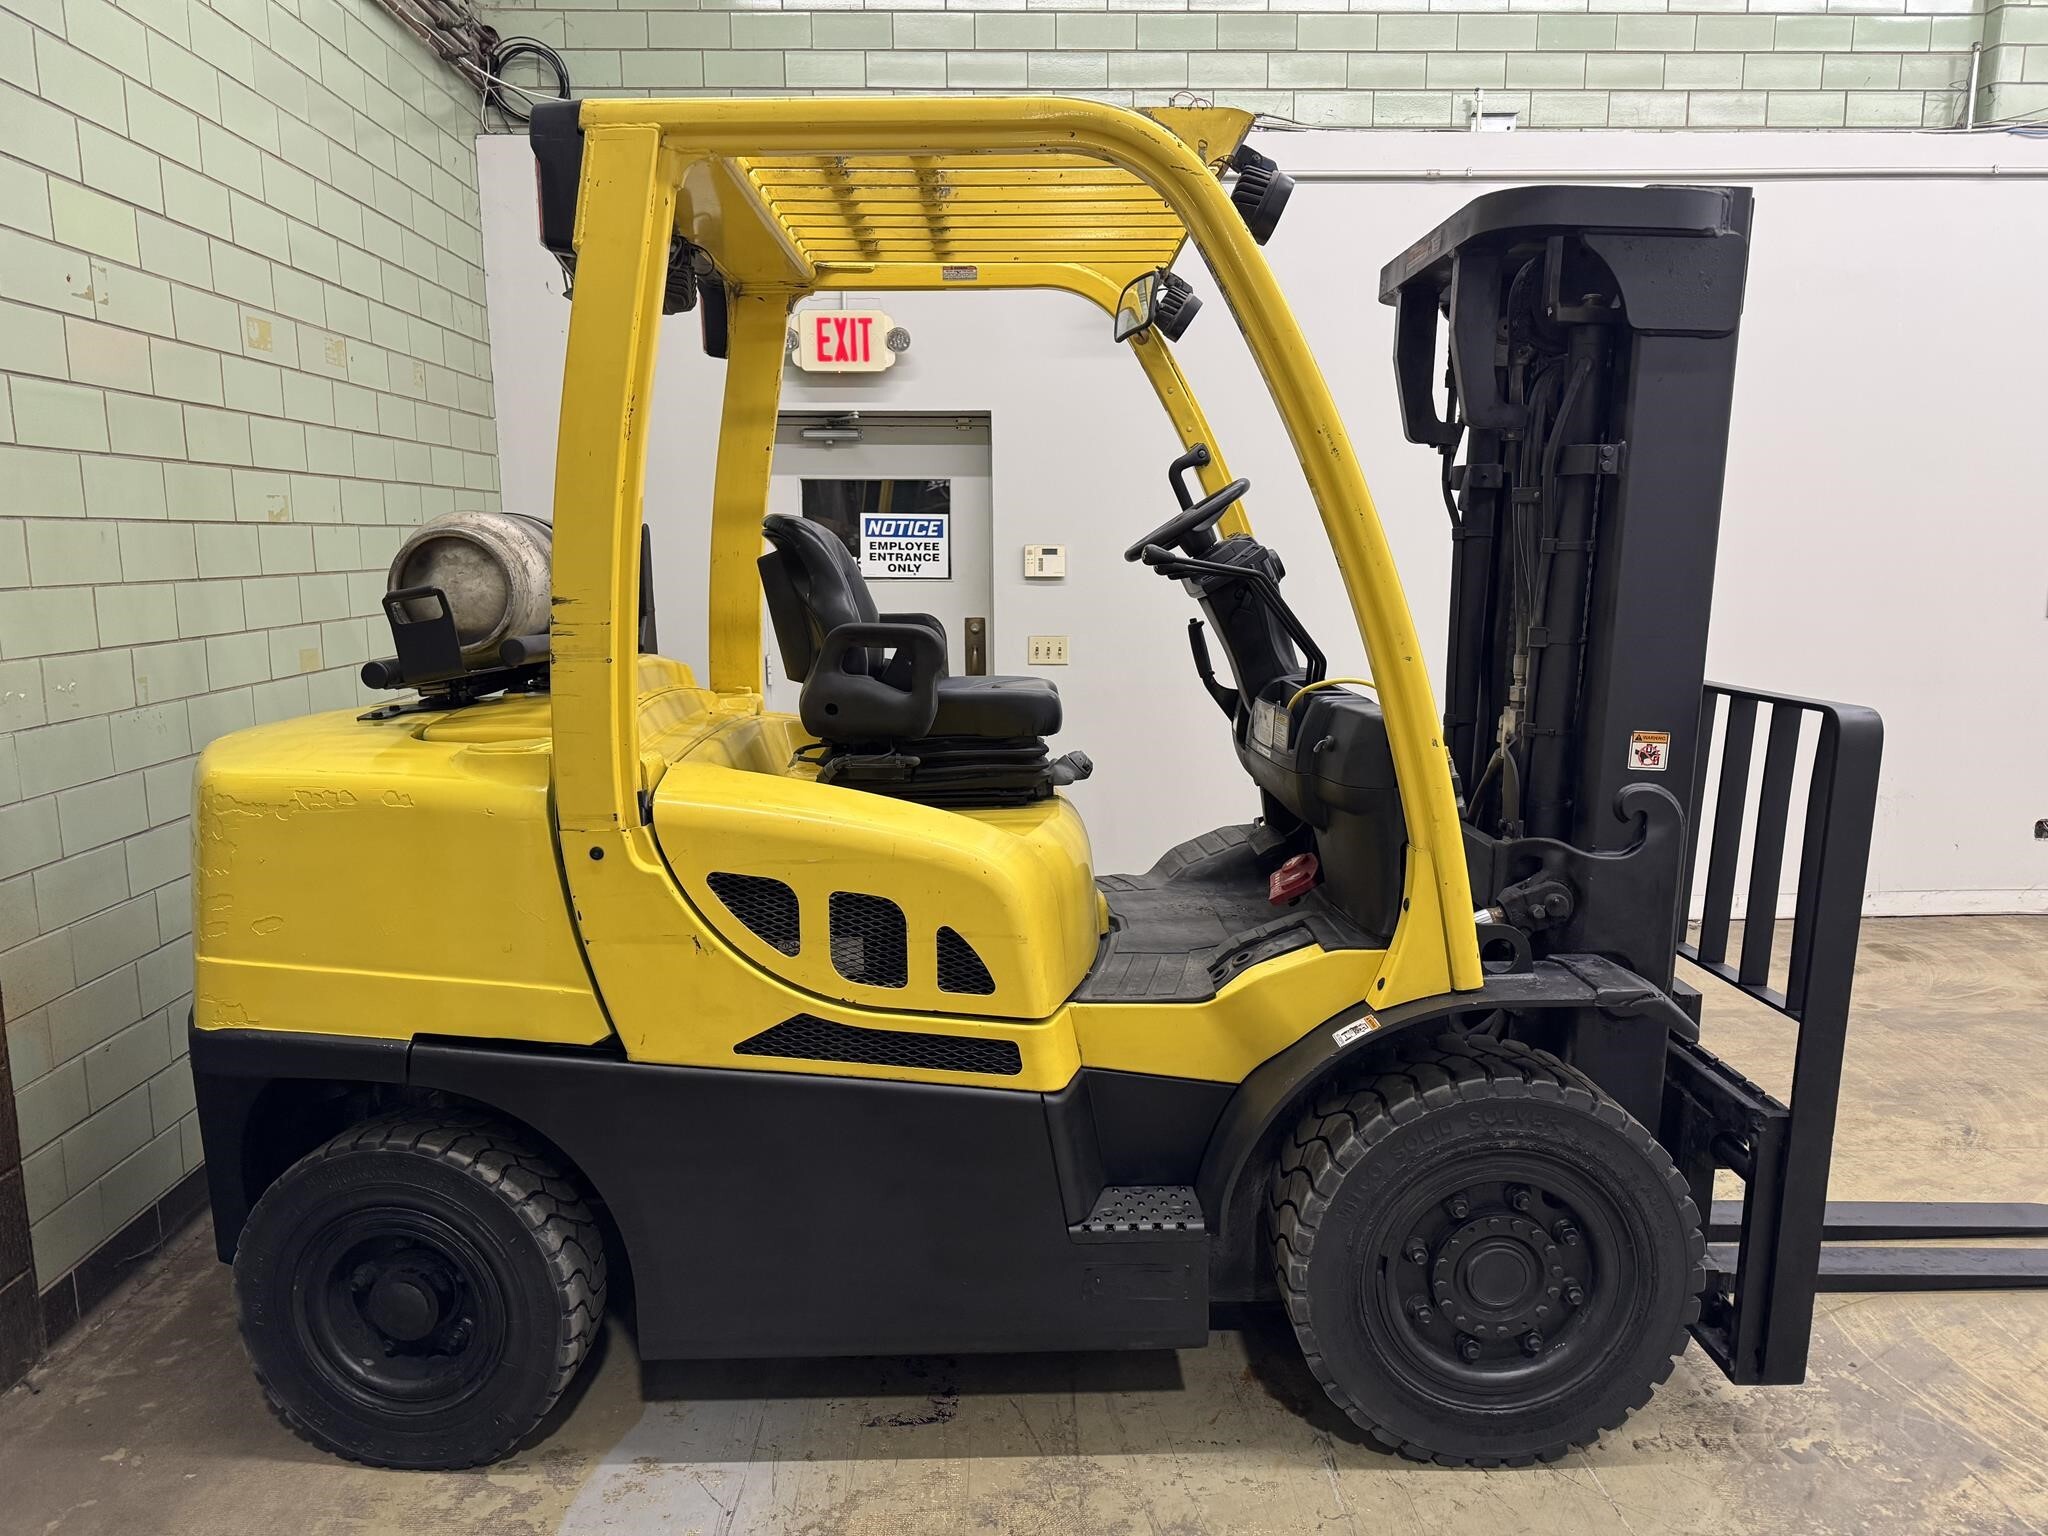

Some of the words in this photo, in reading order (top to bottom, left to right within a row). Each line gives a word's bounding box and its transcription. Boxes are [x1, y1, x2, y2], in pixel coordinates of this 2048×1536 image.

[816, 317, 873, 363] EXIT
[867, 520, 941, 536] NOTICE
[869, 541, 940, 551] EMPLOYEE
[869, 552, 940, 562] ENTRANCE
[887, 563, 922, 573] ONLY
[1389, 1119, 1454, 1160] SOLID
